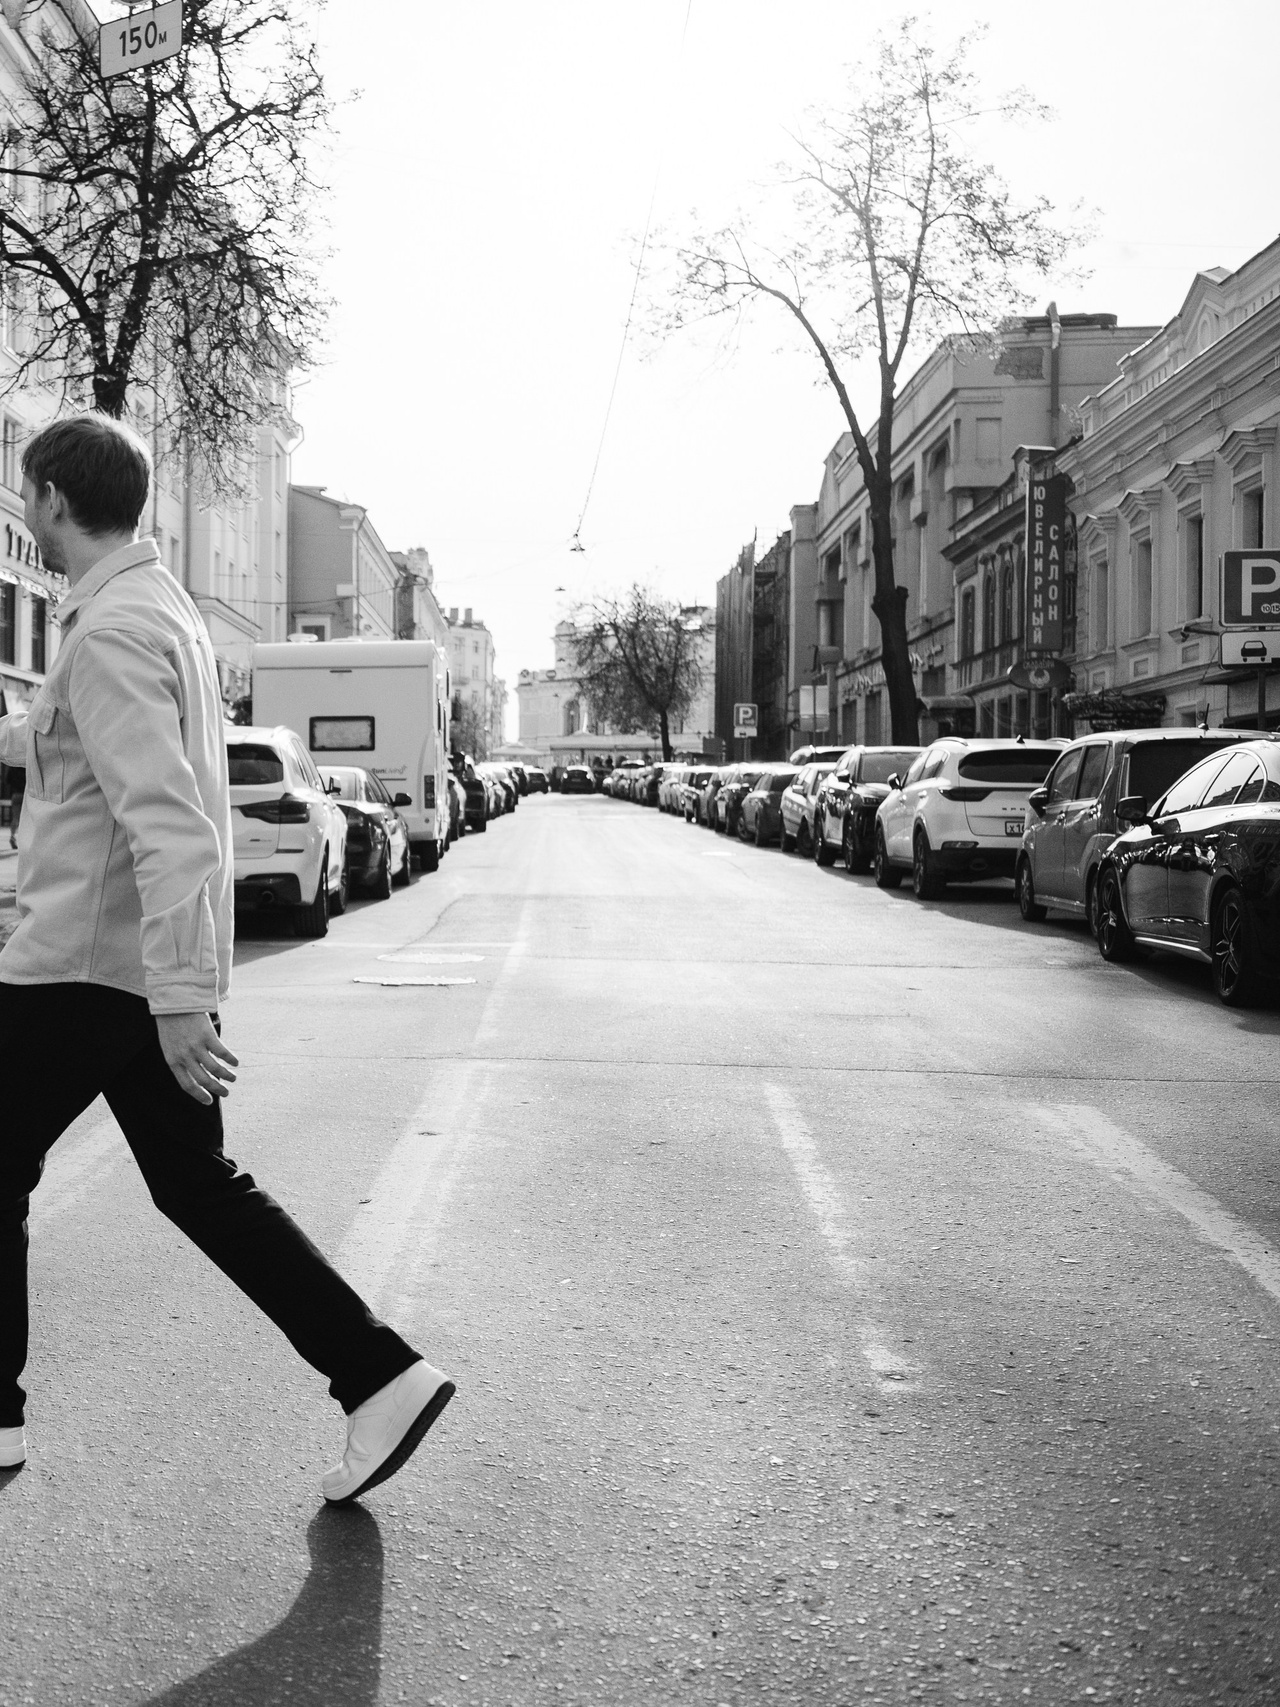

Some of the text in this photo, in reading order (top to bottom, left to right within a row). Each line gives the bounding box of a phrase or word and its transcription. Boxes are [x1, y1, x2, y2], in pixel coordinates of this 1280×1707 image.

[1032, 485, 1046, 645] ЮВЕЛИРНЫЙ
[1047, 524, 1060, 621] САЛОН
[1241, 558, 1280, 616] P
[740, 707, 752, 724] P
